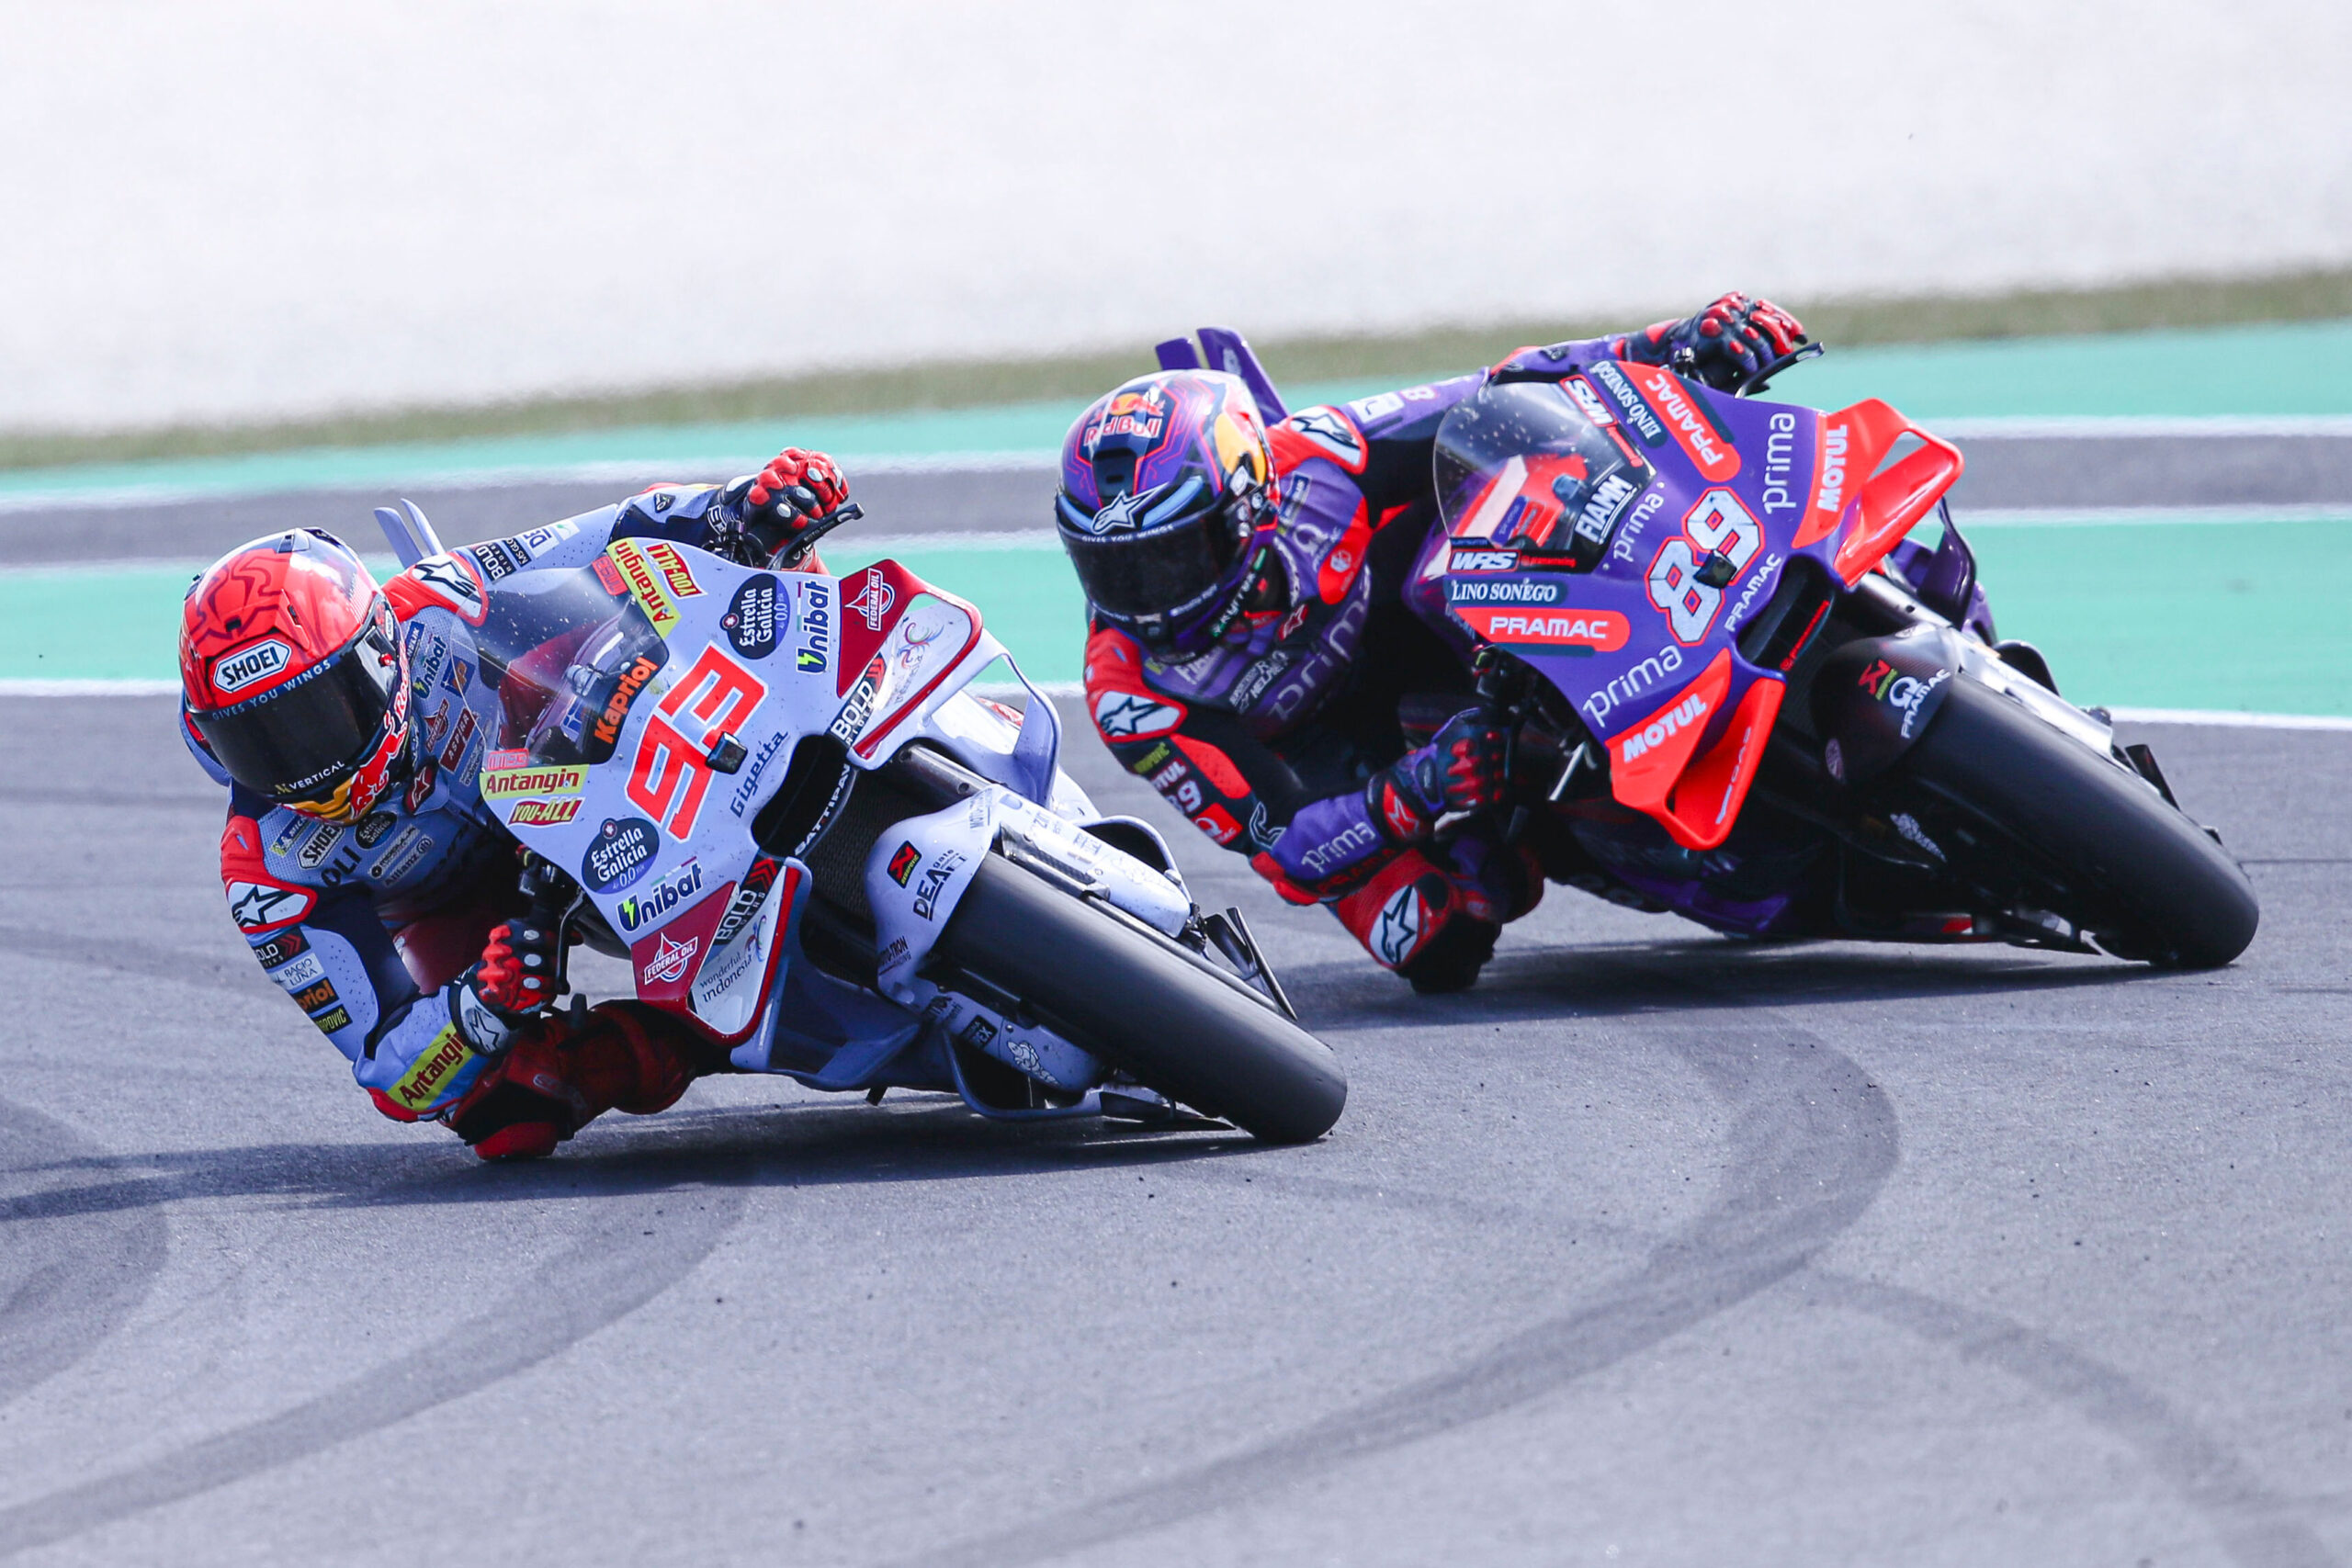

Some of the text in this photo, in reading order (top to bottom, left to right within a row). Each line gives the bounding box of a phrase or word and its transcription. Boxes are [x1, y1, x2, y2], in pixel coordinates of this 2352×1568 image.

[1565, 378, 1613, 423] WRS
[1629, 404, 1661, 439] LINO
[1645, 373, 1724, 467] PRAMAC
[1083, 416, 1116, 446] Rd
[1761, 412, 1797, 514] prima
[1816, 424, 1848, 512] MOTUL
[1575, 474, 1633, 542] FIAMM
[1613, 492, 1664, 562] prima
[476, 546, 505, 581] BOLD
[615, 542, 674, 623] Antangin
[646, 544, 696, 597] YOU-ALL
[1450, 551, 1517, 570] WRS
[1645, 487, 1765, 647] 89
[739, 588, 757, 648] Estrella
[756, 588, 774, 643] Galicia
[869, 591, 879, 627] FEDERAL
[1451, 582, 1487, 602] LINO
[1724, 553, 1781, 632] PRAMAC
[797, 580, 831, 674] Unibat
[1489, 616, 1609, 639] PRAMAC
[212, 659, 332, 721] GIVES YOU WINGS
[221, 647, 280, 686] SHOEI
[413, 635, 447, 699] Unibat
[1583, 645, 1683, 728] prima
[594, 656, 660, 744] Kapriol
[831, 681, 874, 741] BOLD
[1900, 668, 1951, 739] PRAMAC
[628, 642, 768, 842] 93
[1623, 694, 1707, 762] MOTUL
[288, 761, 345, 790] VERTICAL
[484, 768, 581, 795] Antangin
[730, 732, 788, 818] Gigetta
[512, 798, 578, 822] YOU-ALL
[591, 828, 644, 868] Estrella
[597, 844, 648, 882] Galicia
[1301, 821, 1376, 874] prima
[616, 861, 703, 932] Unibat
[717, 889, 758, 941] BOLD
[289, 967, 319, 987] LUNA
[647, 953, 680, 979] FEDERAL
[699, 952, 742, 989] wonderful
[702, 954, 753, 1003] indonesia
